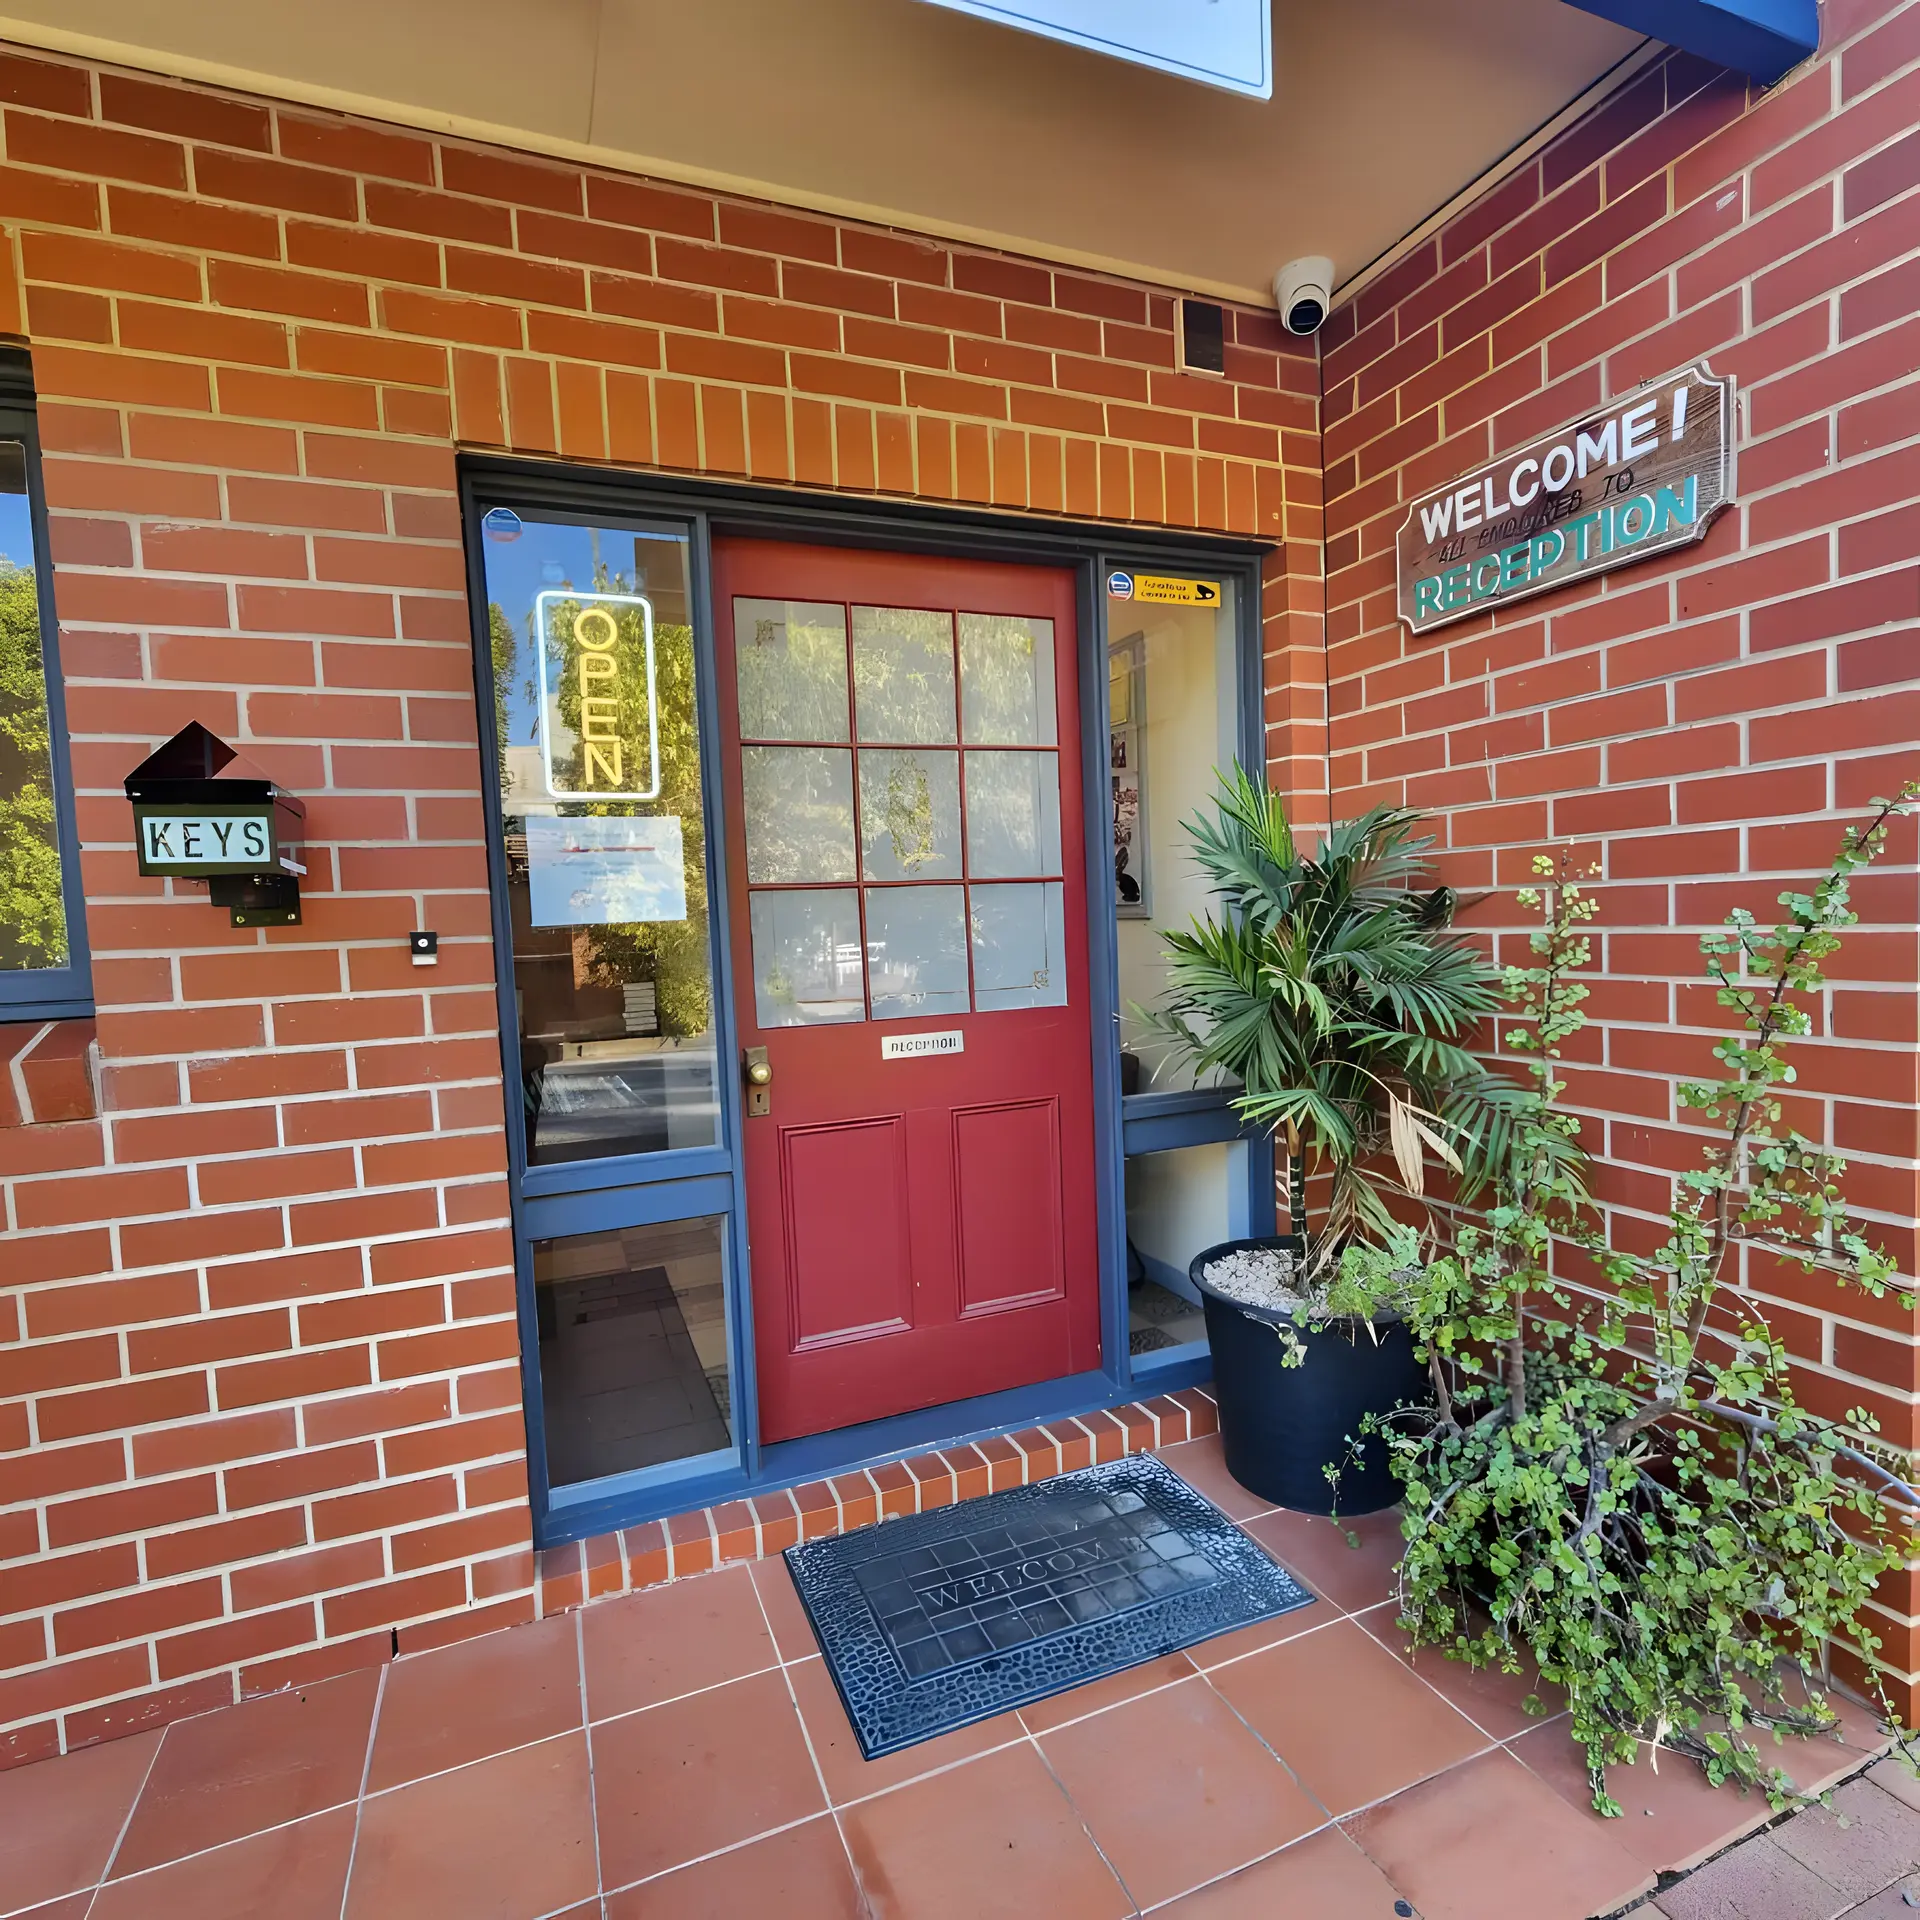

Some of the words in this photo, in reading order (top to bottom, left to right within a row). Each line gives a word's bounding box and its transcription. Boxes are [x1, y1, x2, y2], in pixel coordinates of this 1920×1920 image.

[1602, 467, 1635, 500] TO
[1415, 474, 1699, 619] RECEPTION
[573, 608, 623, 787] OPEN
[149, 821, 265, 858] KEYS
[922, 1535, 1148, 1608] WELCOM
